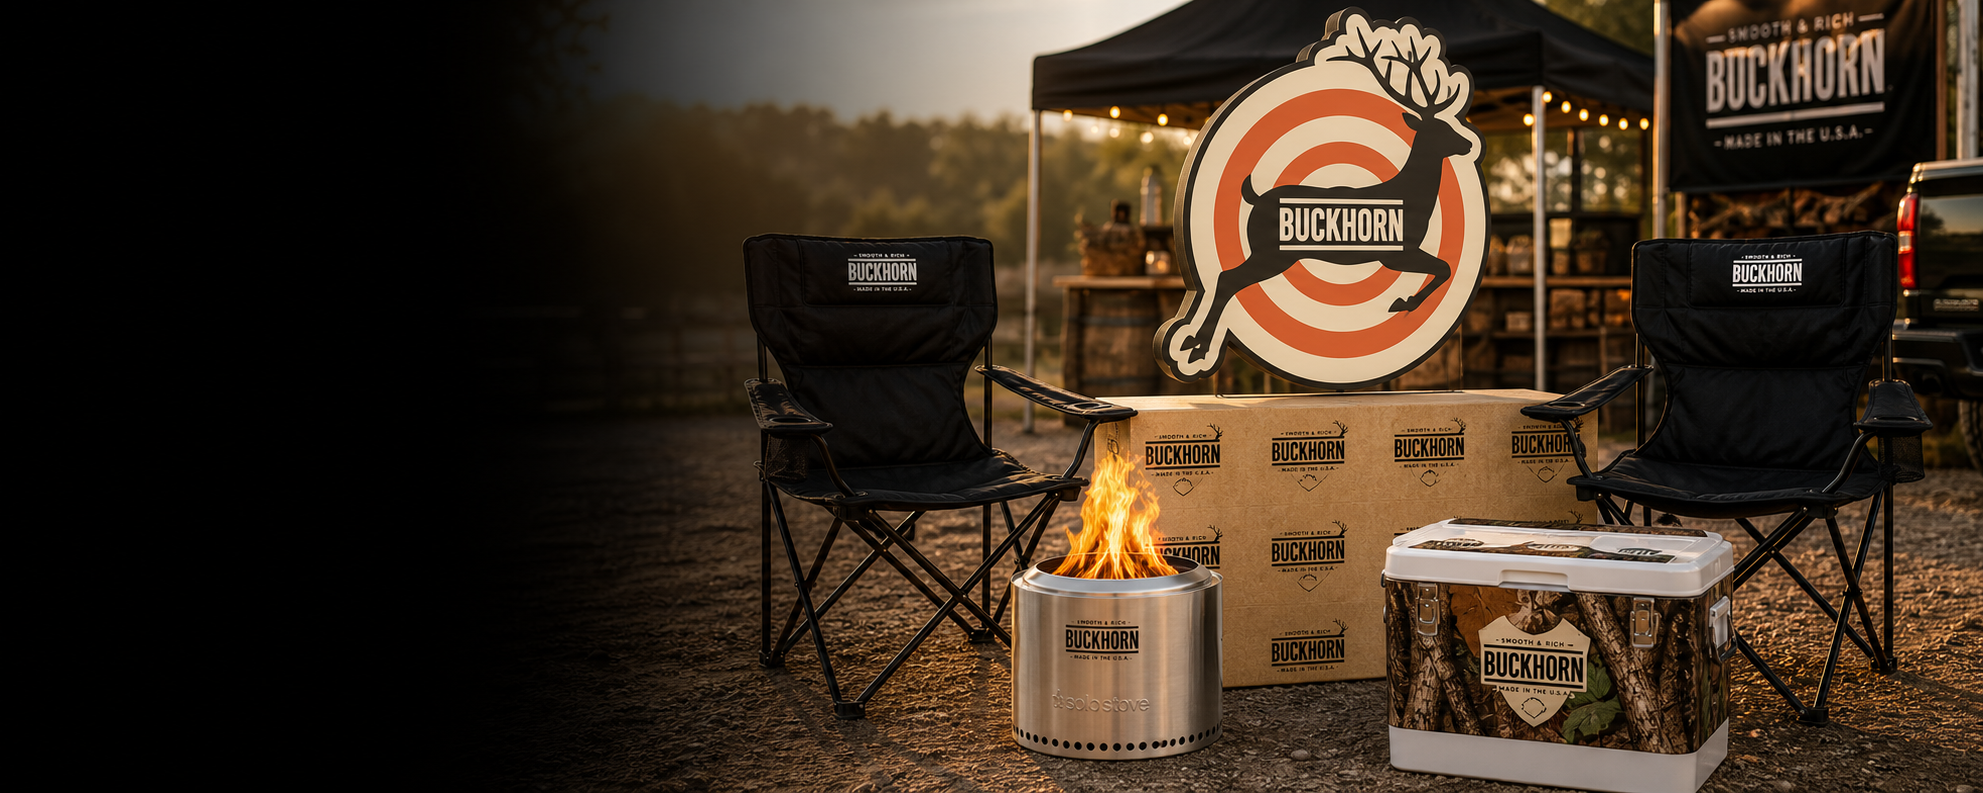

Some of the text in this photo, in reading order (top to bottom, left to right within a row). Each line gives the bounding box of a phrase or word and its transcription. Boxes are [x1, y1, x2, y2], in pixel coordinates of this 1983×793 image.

[1728, 12, 1854, 43] SMOOTH & RICH
[1706, 29, 1885, 113] BUCKHORN
[1724, 125, 1863, 150] MADE IN THE U.S.A.
[1280, 208, 1403, 241] BUCKHORN
[848, 262, 917, 281] BUCKHORN
[1732, 263, 1802, 282] BUCKHORN
[1146, 444, 1220, 465] BUCKHORN
[1272, 440, 1344, 461] BUCKHORN
[1395, 437, 1464, 457] BUCKHORN
[1272, 540, 1344, 562] BUCKHORN
[1066, 629, 1139, 649] BUCKHORN
[1272, 639, 1344, 662] BUCKHORN
[1484, 651, 1583, 683] BUCKHORN
